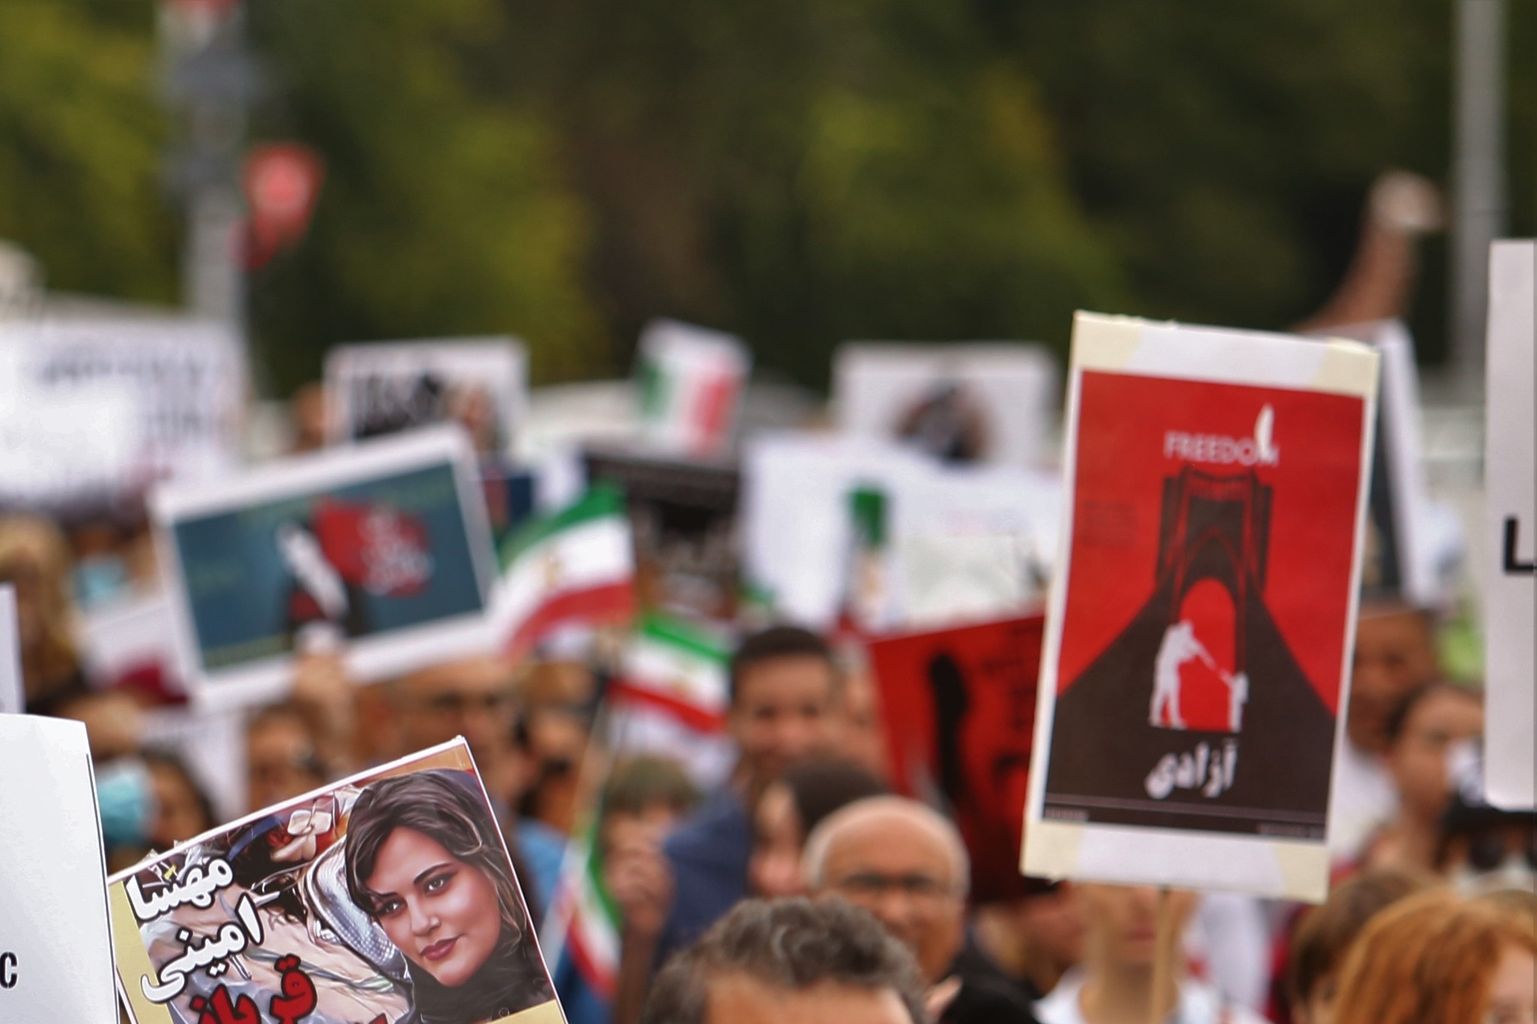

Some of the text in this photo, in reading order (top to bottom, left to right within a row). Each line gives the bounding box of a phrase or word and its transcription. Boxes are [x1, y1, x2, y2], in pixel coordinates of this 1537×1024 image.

[1145, 738, 1238, 799] آزادی
[125, 857, 233, 921] مهسا
[141, 893, 264, 1003] امینی
